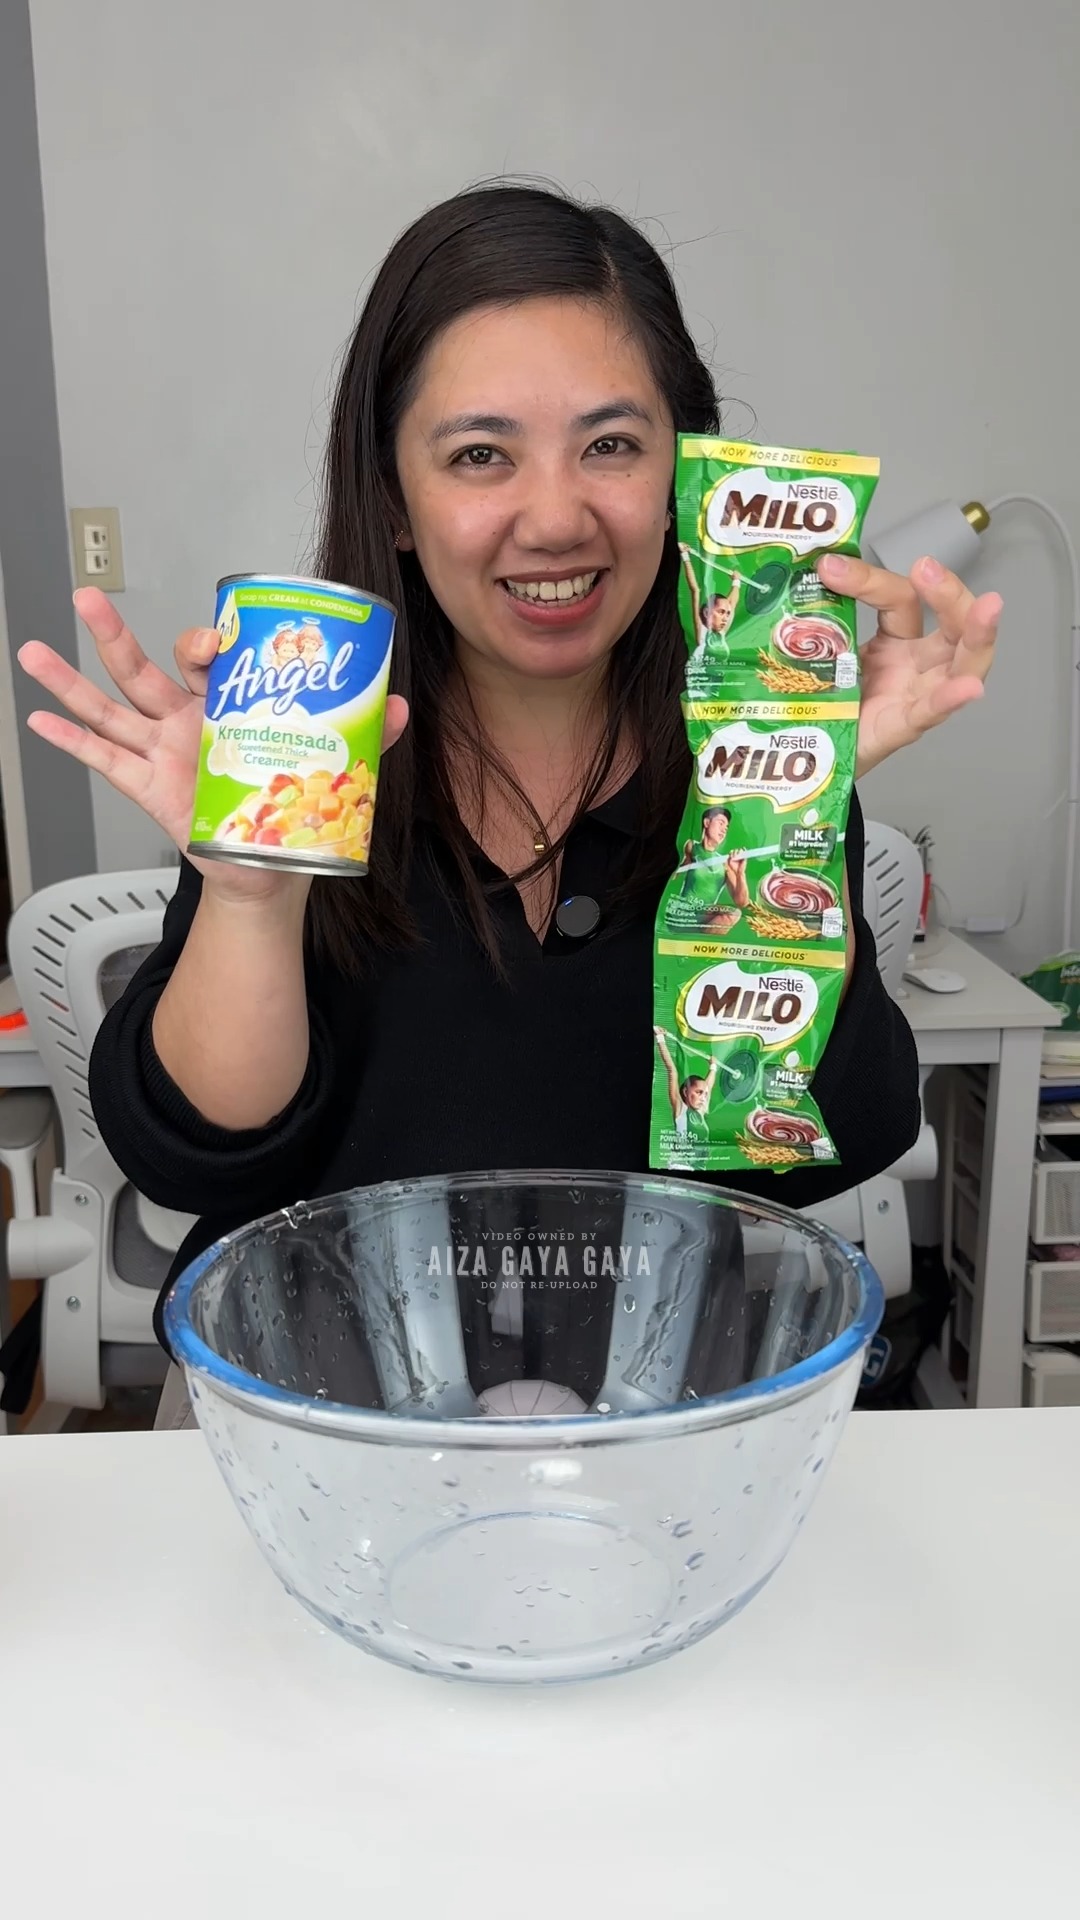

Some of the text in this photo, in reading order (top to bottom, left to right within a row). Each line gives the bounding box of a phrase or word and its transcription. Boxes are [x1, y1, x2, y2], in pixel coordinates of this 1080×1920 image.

[719, 446, 839, 468] NOW MORE DELICIOUS
[719, 490, 837, 533] MILO
[742, 531, 784, 540] NOURISHING
[803, 573, 821, 584] MIL
[268, 593, 300, 604] CREAM
[309, 598, 363, 618] CONDENSADA
[211, 641, 354, 719] Angel
[702, 705, 819, 716] NOW MORE DELICIOUS
[218, 725, 338, 752] Kremdensada
[237, 743, 309, 758] Sweetened Thick
[243, 753, 300, 769] Creamer
[704, 745, 817, 783] MILO
[725, 782, 765, 791] NOURISHING
[794, 829, 824, 841] MILK
[693, 945, 806, 961] NOW MORE DELICIOUS
[697, 984, 802, 1025] MILO
[717, 1021, 755, 1031] NOURISHING
[776, 1070, 805, 1083] MILK
